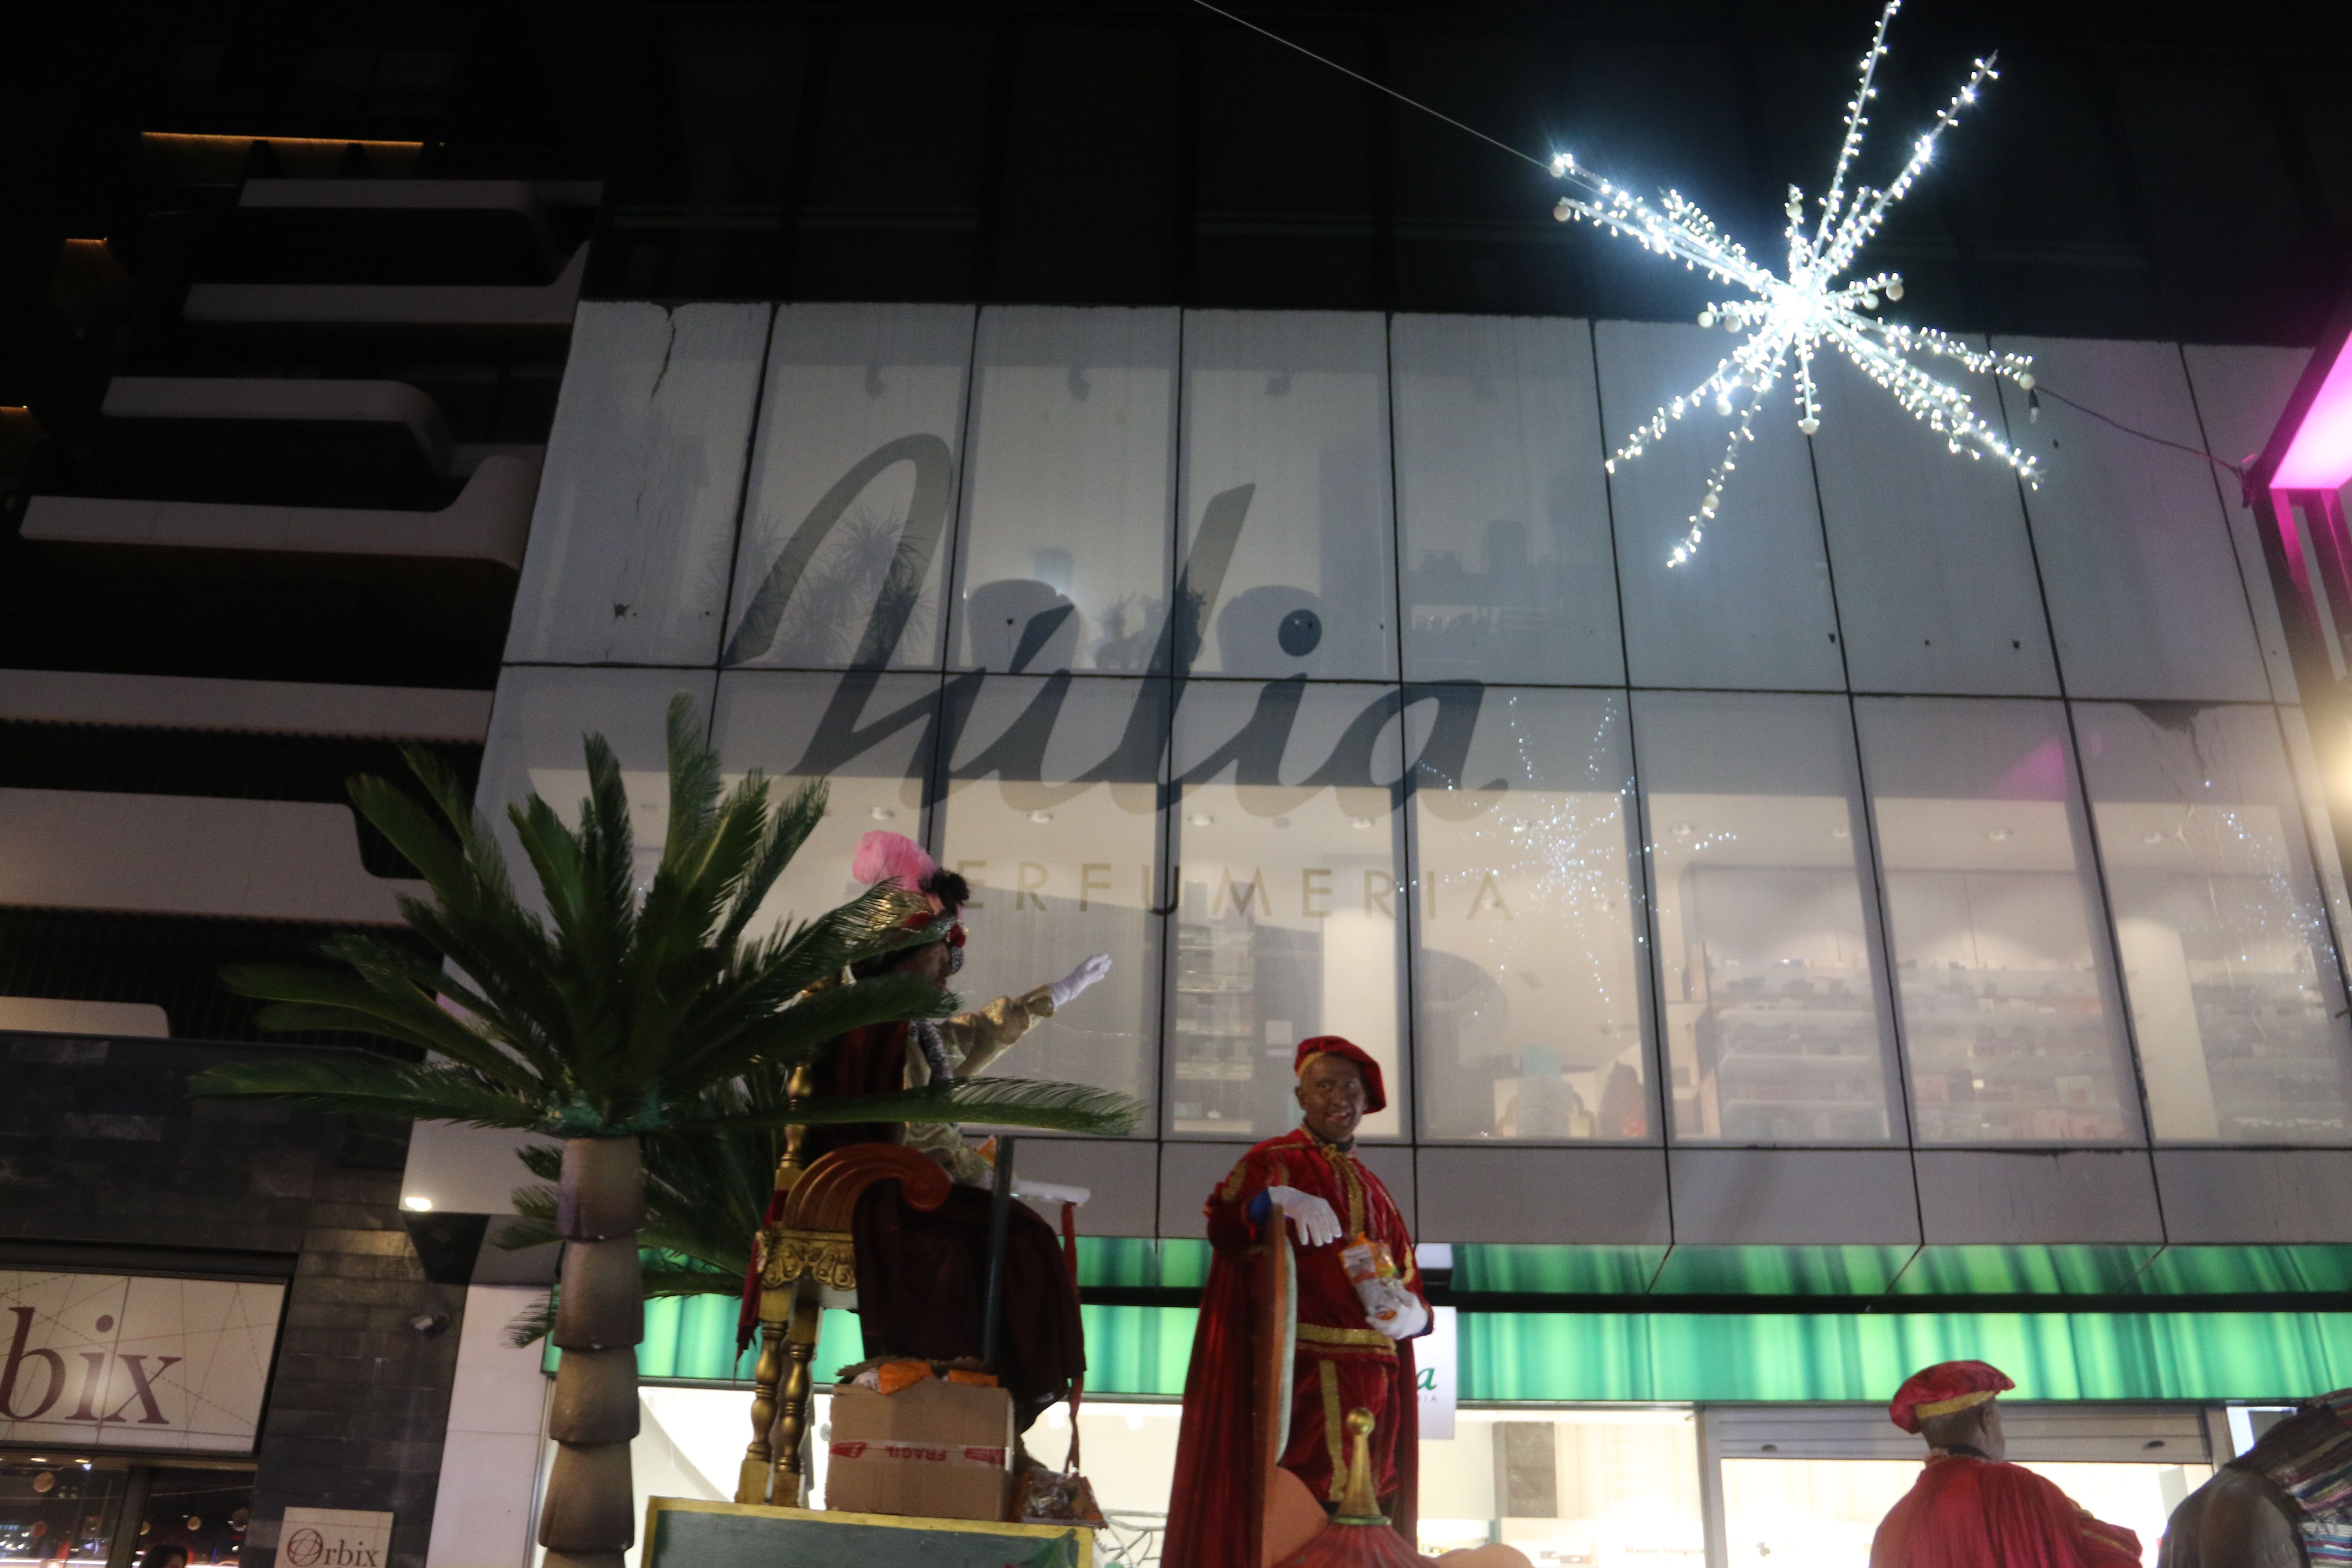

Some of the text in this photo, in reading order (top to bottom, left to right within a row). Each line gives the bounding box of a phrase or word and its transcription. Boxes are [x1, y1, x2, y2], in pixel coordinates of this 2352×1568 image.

[956, 860, 1514, 921] ERFUMERIA
[0, 1306, 182, 1425] bix
[287, 1528, 379, 1567] Orbix
